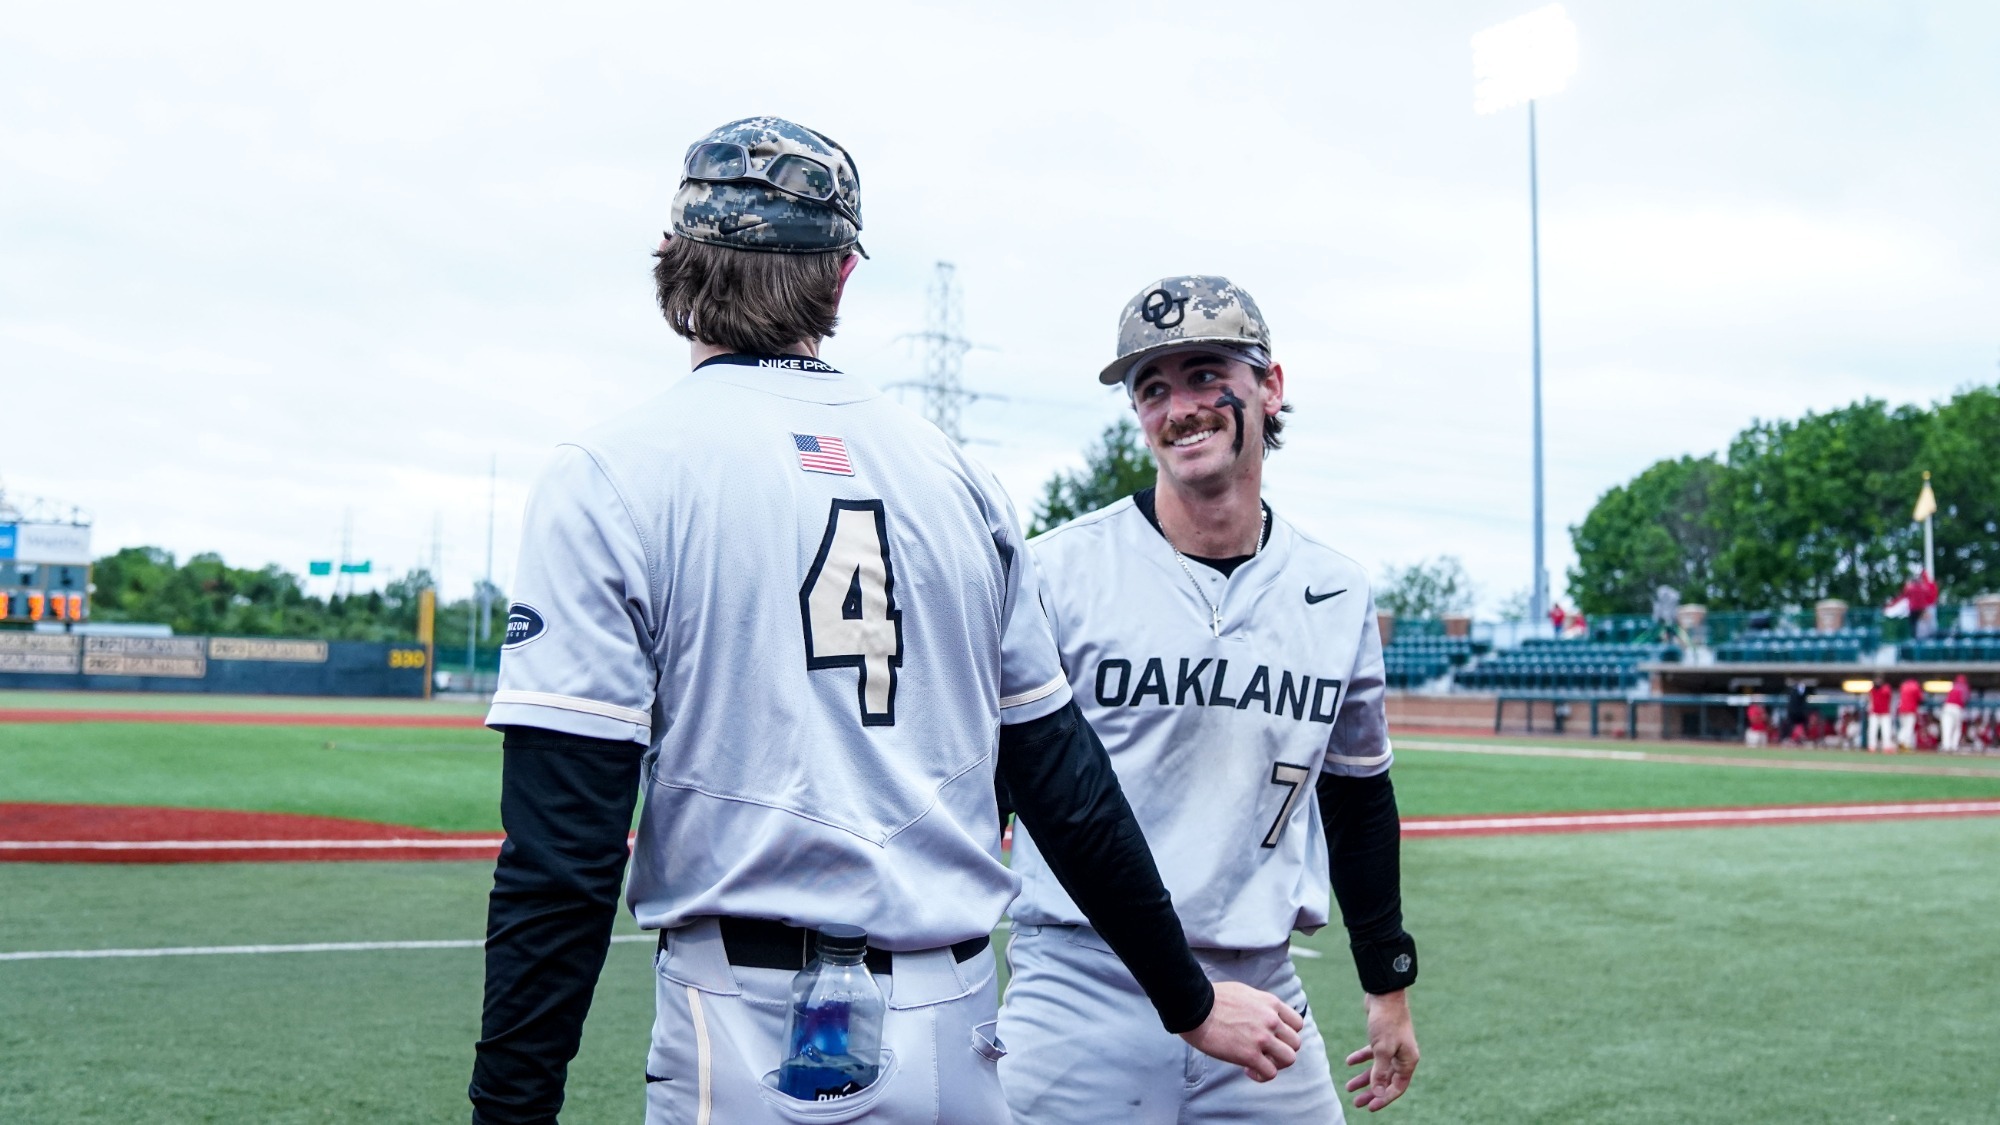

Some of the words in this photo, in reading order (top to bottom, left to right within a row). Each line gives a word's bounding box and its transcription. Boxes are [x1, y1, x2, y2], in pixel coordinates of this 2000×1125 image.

[1141, 288, 1189, 330] OU
[758, 359, 801, 370] NIKE
[798, 497, 905, 727] 4
[389, 649, 425, 668] 330
[1094, 657, 1342, 725] OAKLAND
[1260, 761, 1311, 849] 7
